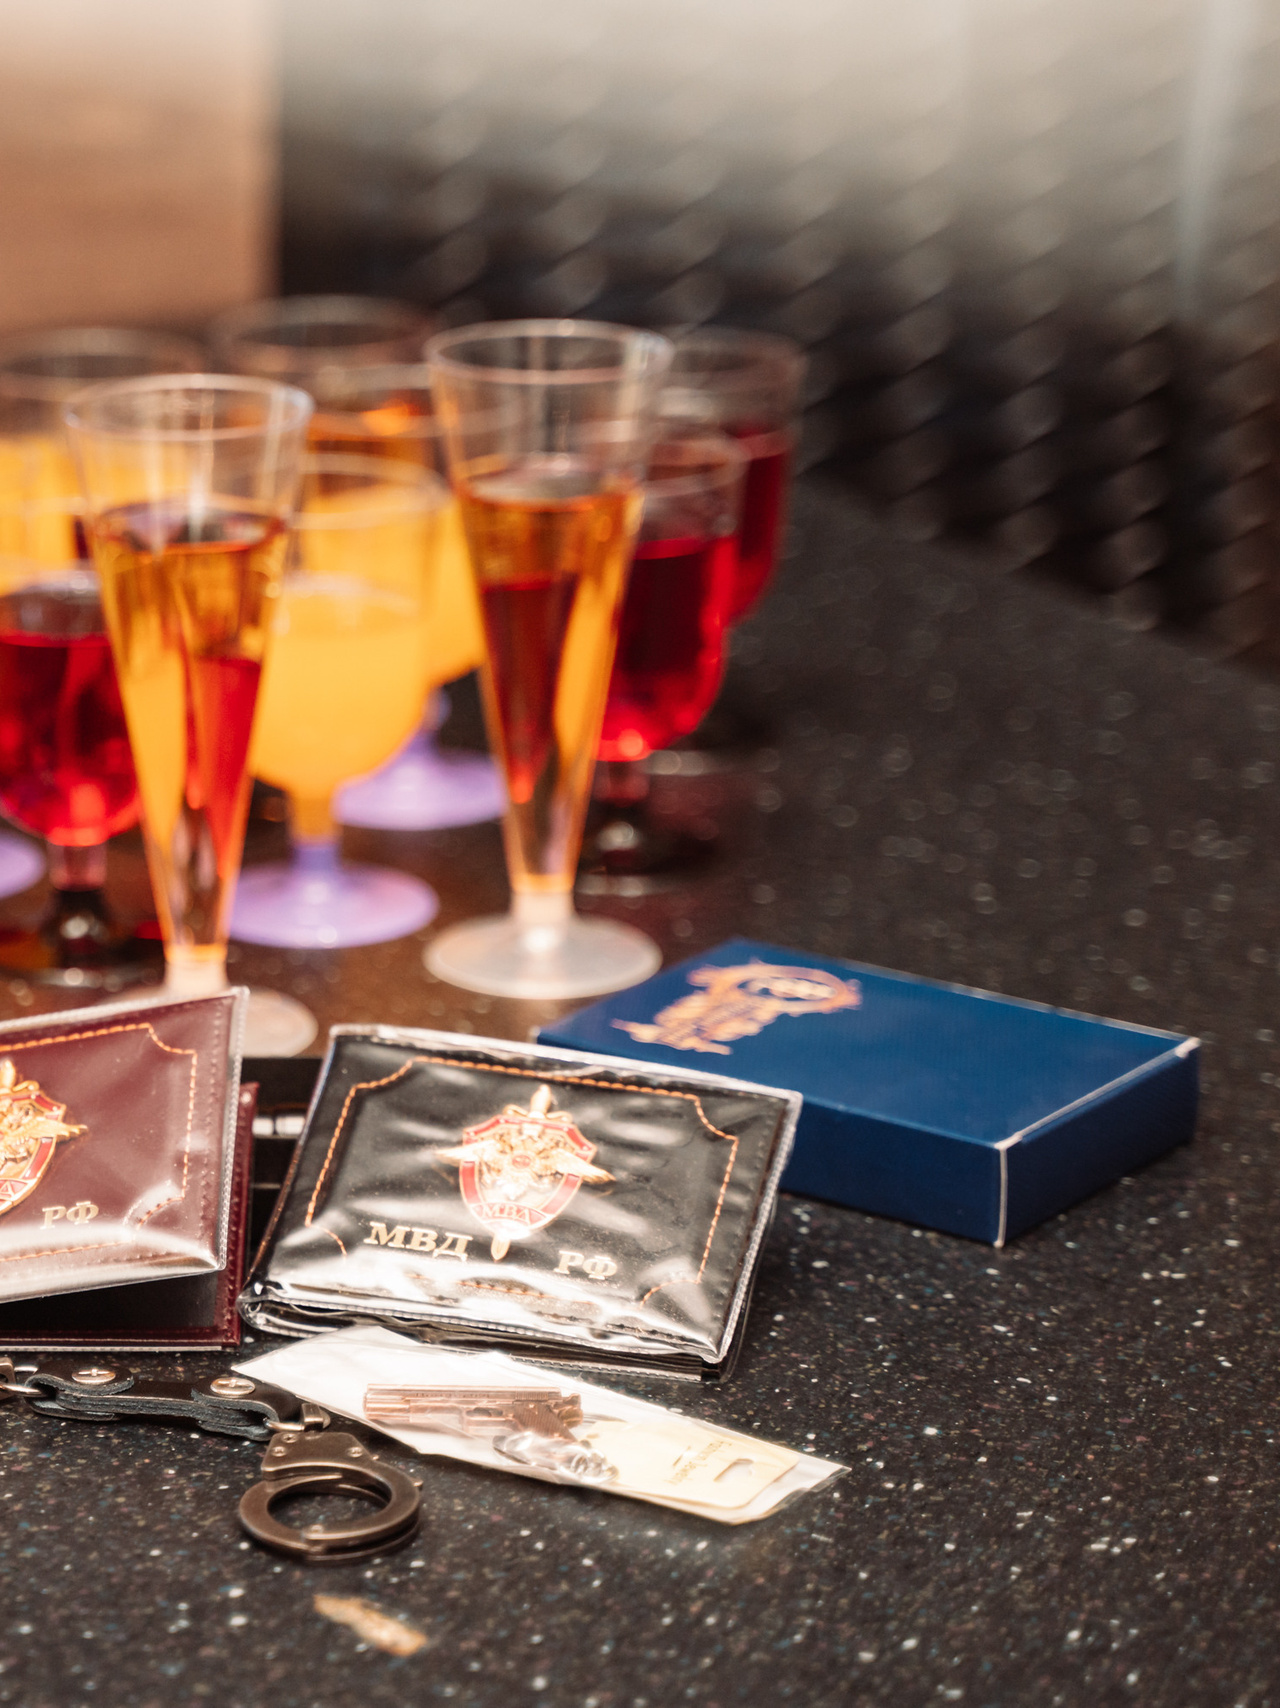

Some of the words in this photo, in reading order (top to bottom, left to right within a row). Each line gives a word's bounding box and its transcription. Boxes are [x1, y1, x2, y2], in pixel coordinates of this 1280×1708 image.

[40, 1201, 99, 1230] РФ
[480, 1203, 532, 1225] МВД
[363, 1221, 473, 1262] МВД
[553, 1250, 618, 1280] РФ
